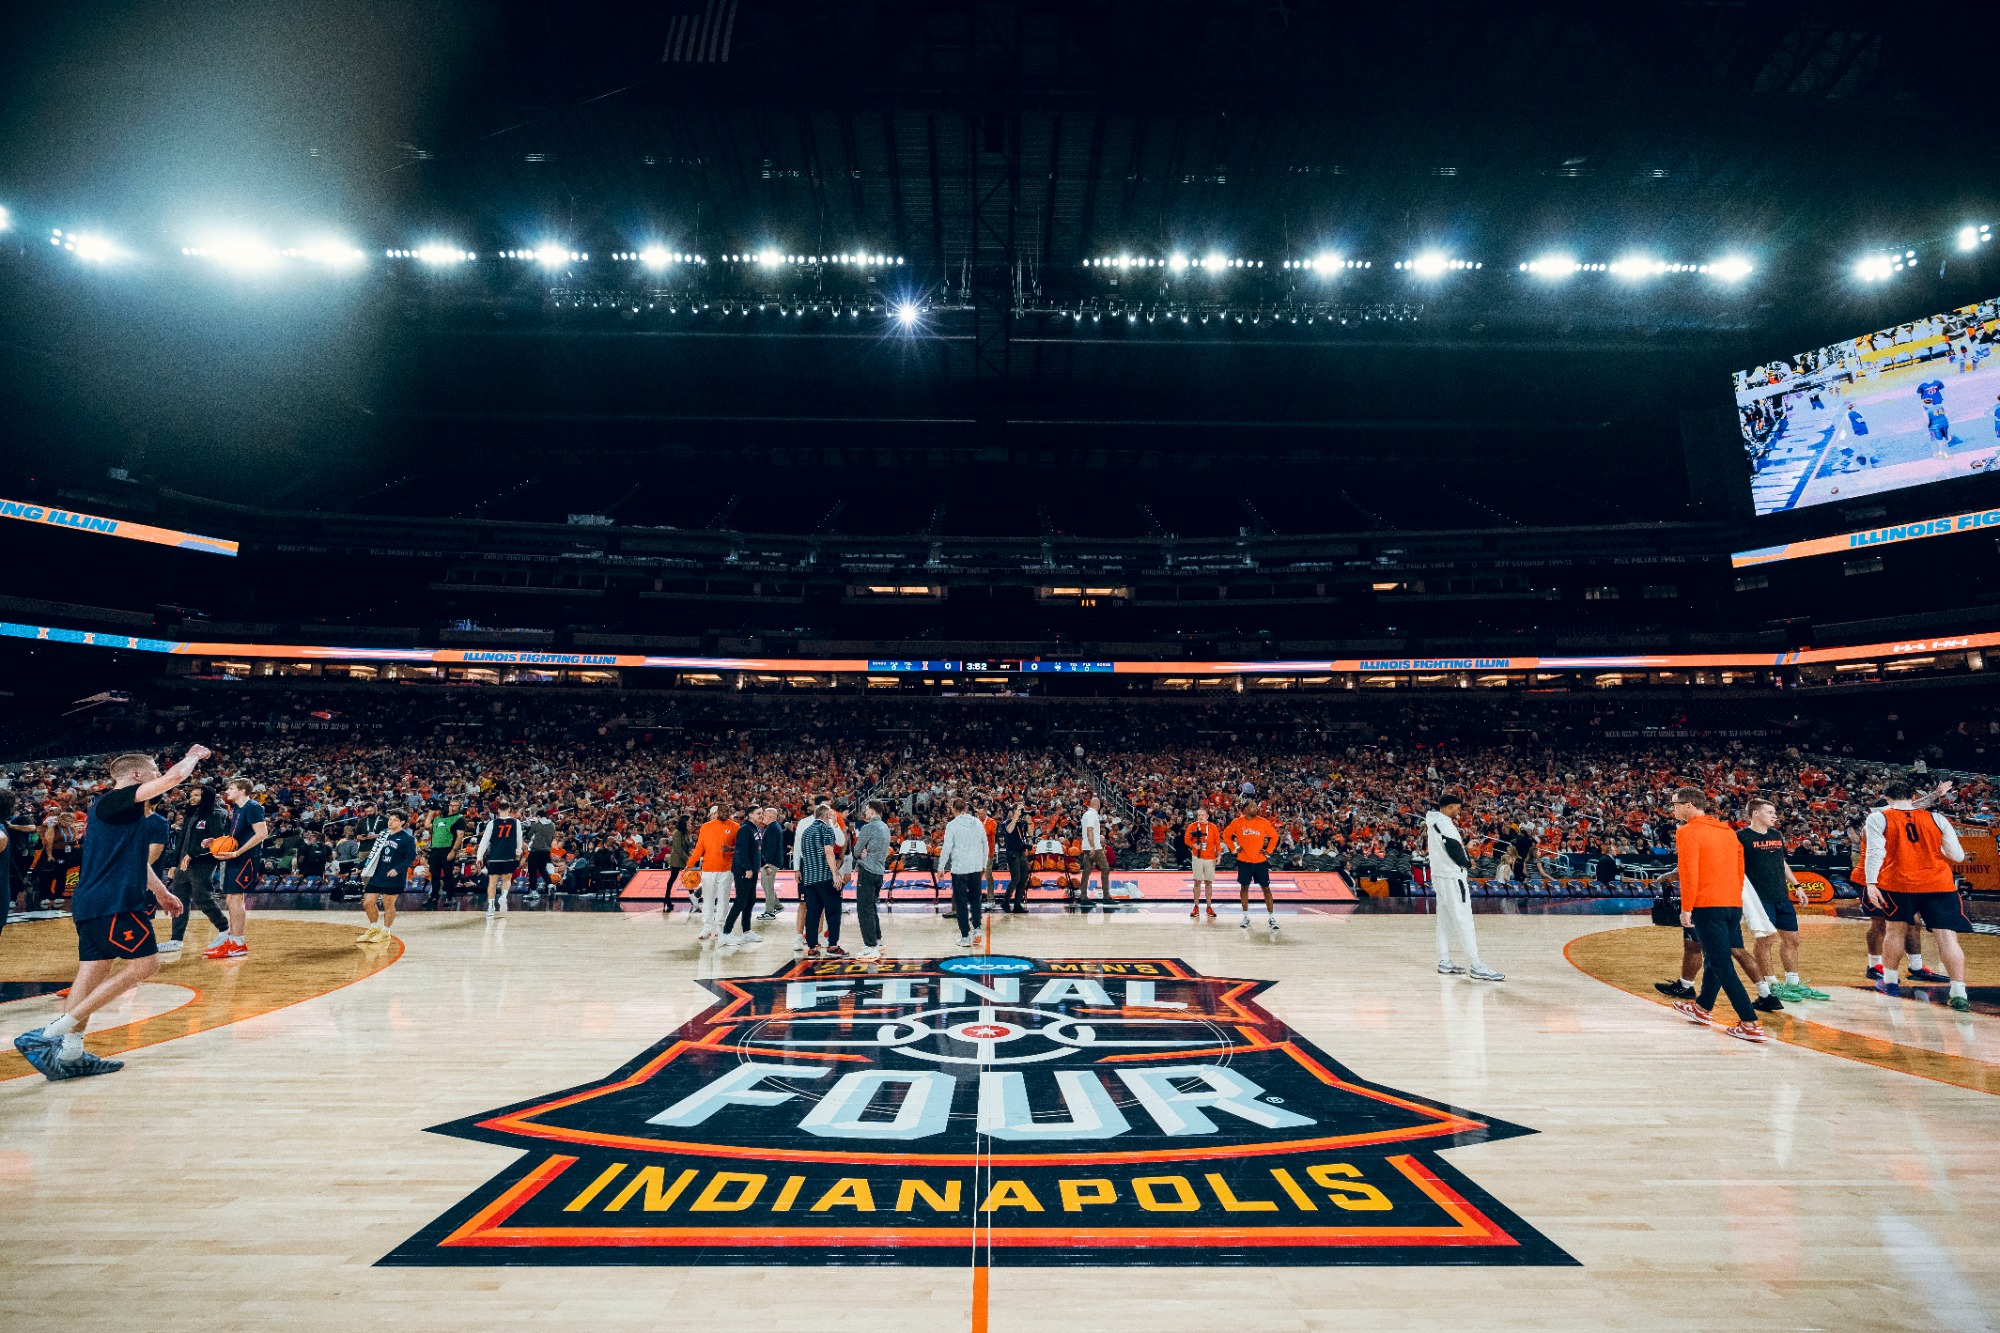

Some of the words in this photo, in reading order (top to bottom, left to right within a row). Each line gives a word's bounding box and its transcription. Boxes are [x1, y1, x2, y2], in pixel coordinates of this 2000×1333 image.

[47, 510, 118, 533] ILLINI
[1850, 519, 1951, 547] ILLINOIS
[1957, 511, 2000, 530] FIG
[463, 652, 516, 662] ILLINOIS
[518, 653, 580, 664] FIGHTING
[582, 656, 616, 664] ILLINI
[944, 662, 952, 670] 0
[1360, 660, 1411, 670] ILLINOIS
[1413, 660, 1472, 670] FIGHTING
[1475, 660, 1509, 669] ILLINI
[498, 824, 512, 838] 77
[1906, 822, 1918, 842] 0
[1966, 864, 1990, 874] INDY
[1050, 964, 1159, 974] MEN'S
[786, 977, 1188, 1009] FINAL
[648, 1064, 1318, 1138] FOUR
[563, 1163, 1394, 1213] INDIANAPOLIS
